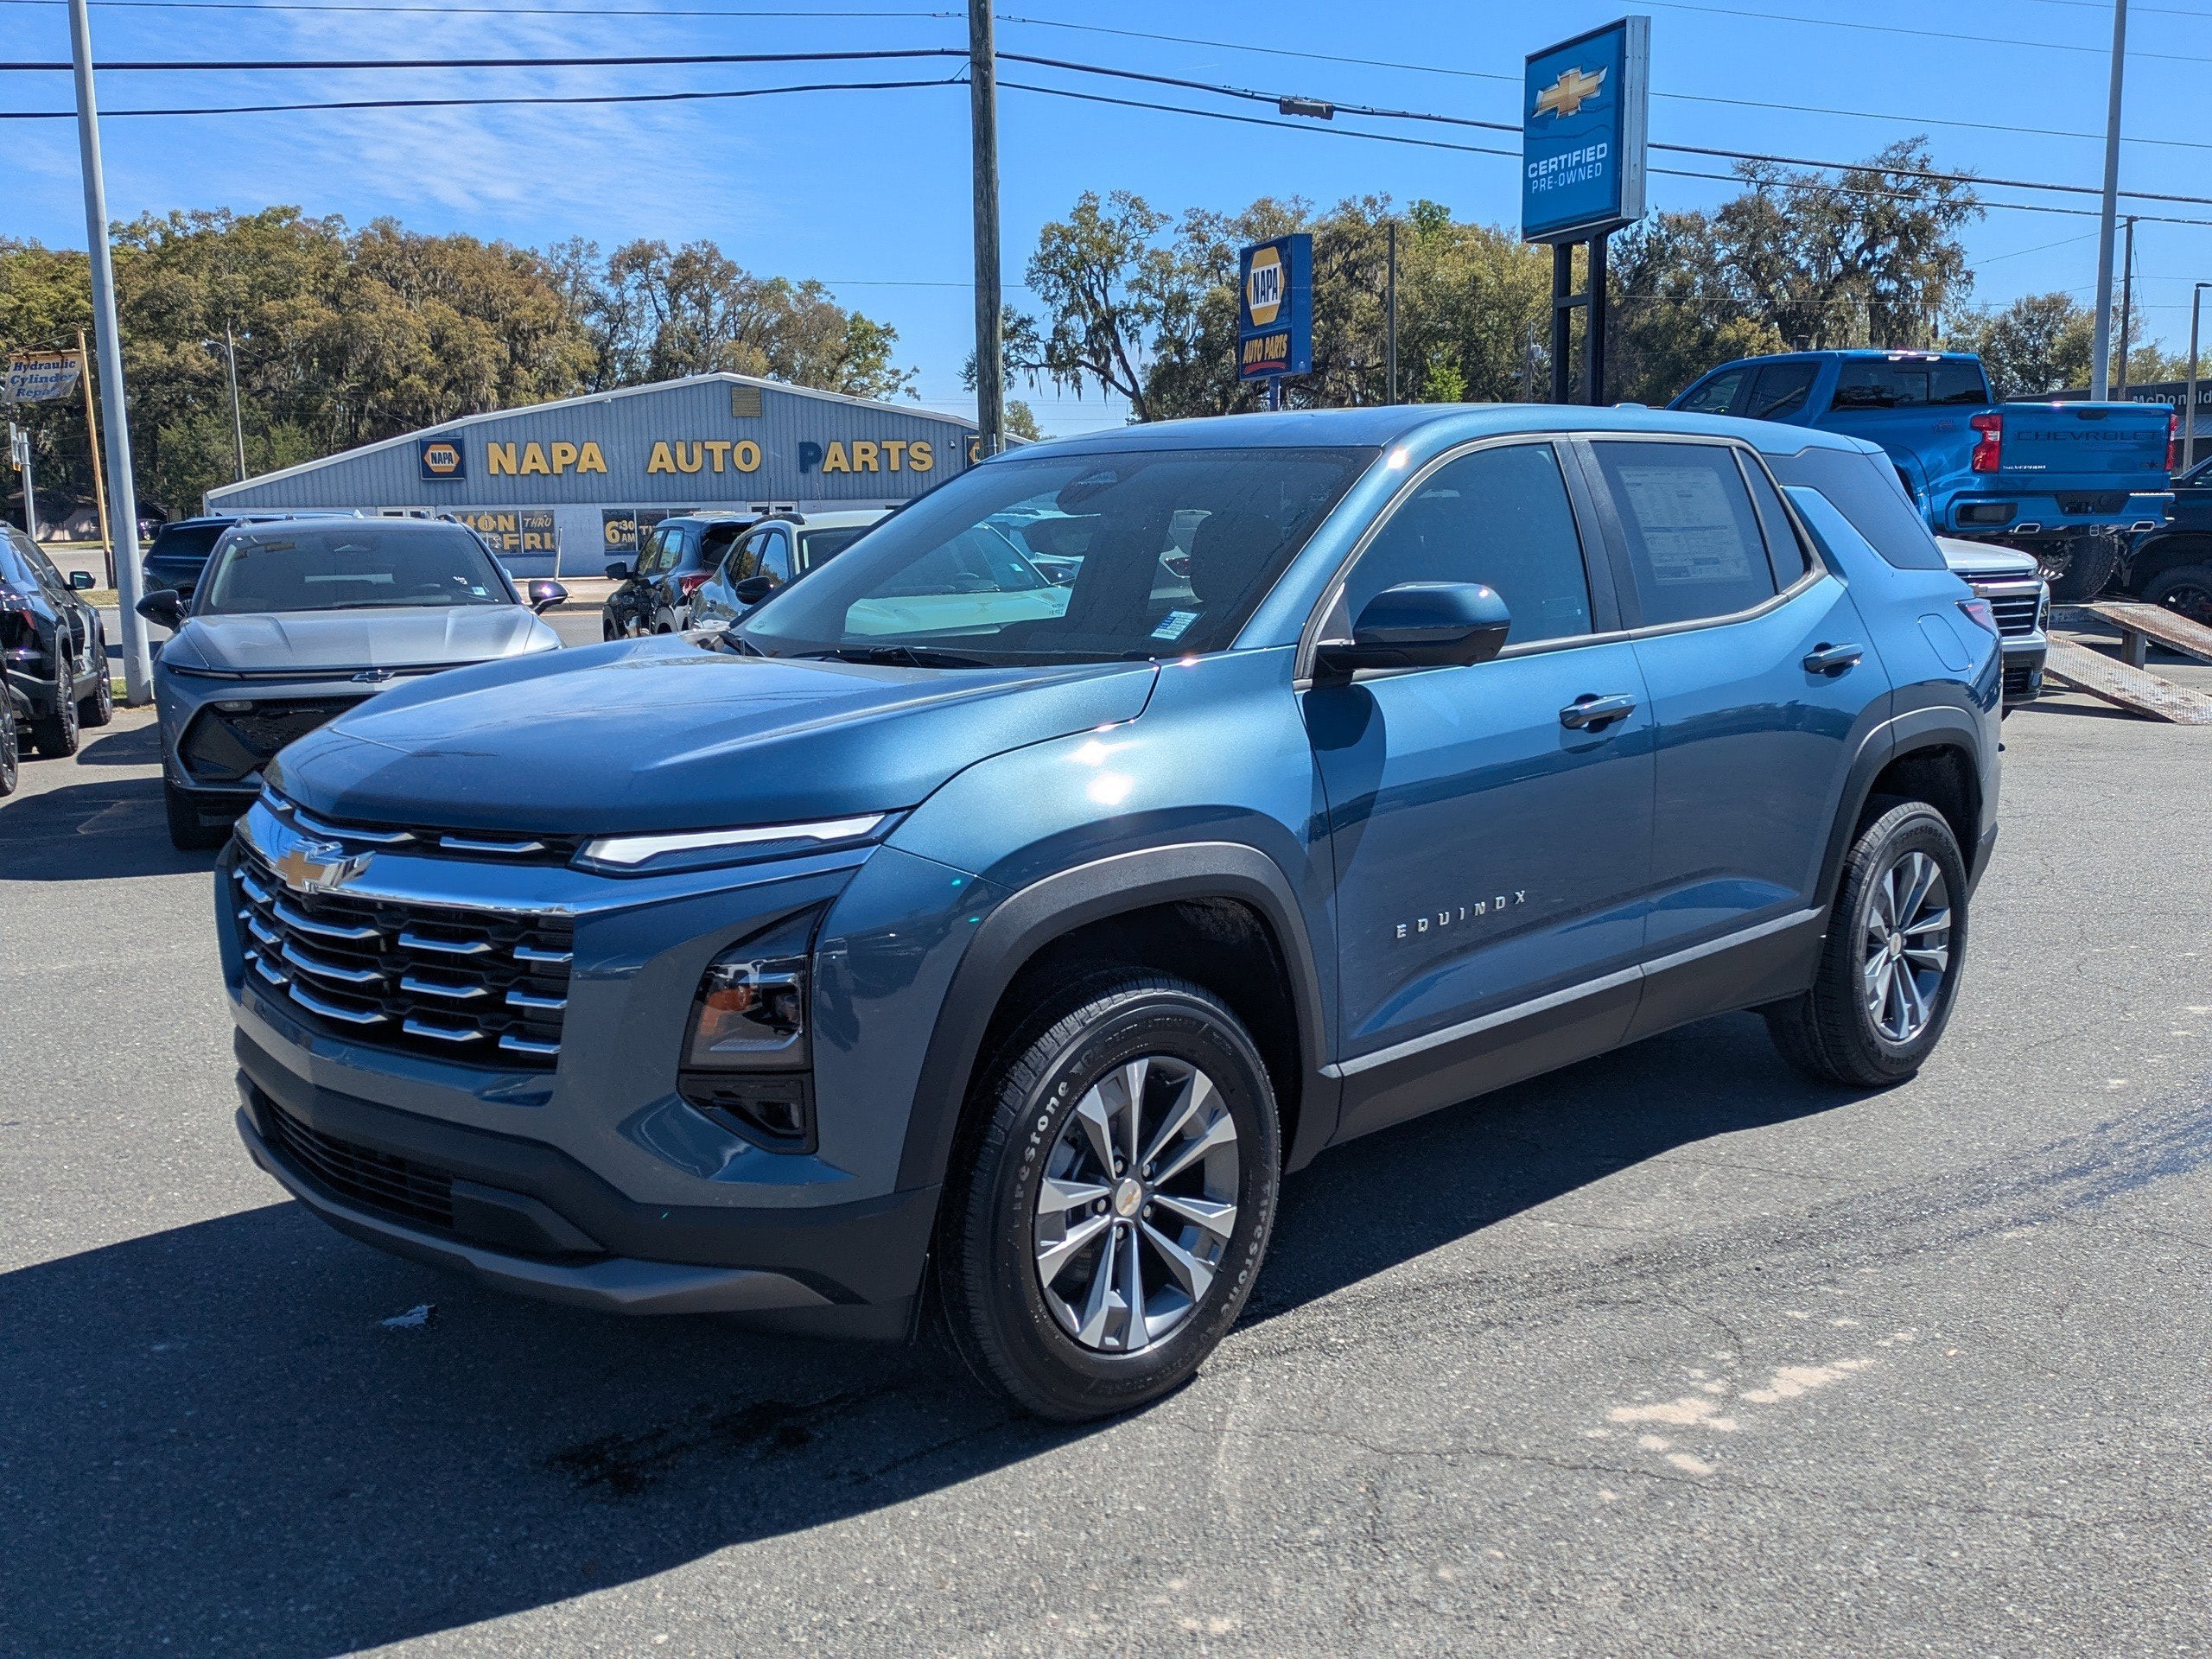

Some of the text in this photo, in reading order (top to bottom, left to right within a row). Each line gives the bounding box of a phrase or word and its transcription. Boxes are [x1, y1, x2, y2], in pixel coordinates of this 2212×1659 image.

[1528, 143, 1608, 178] CERTIFIED
[1532, 162, 1602, 194] PRE-OWNED
[1253, 267, 1278, 305] NAPA
[1243, 334, 1287, 364] AUTO PARTS
[13, 359, 76, 372] Hydraulic
[2017, 430, 2158, 442] CHEVROLET
[430, 451, 454, 466] NAPA
[487, 439, 934, 474] NAPA AUTO PARTS
[523, 518, 552, 528] THRU
[621, 532, 636, 543] AM
[1395, 890, 1526, 939] EQUINOX
